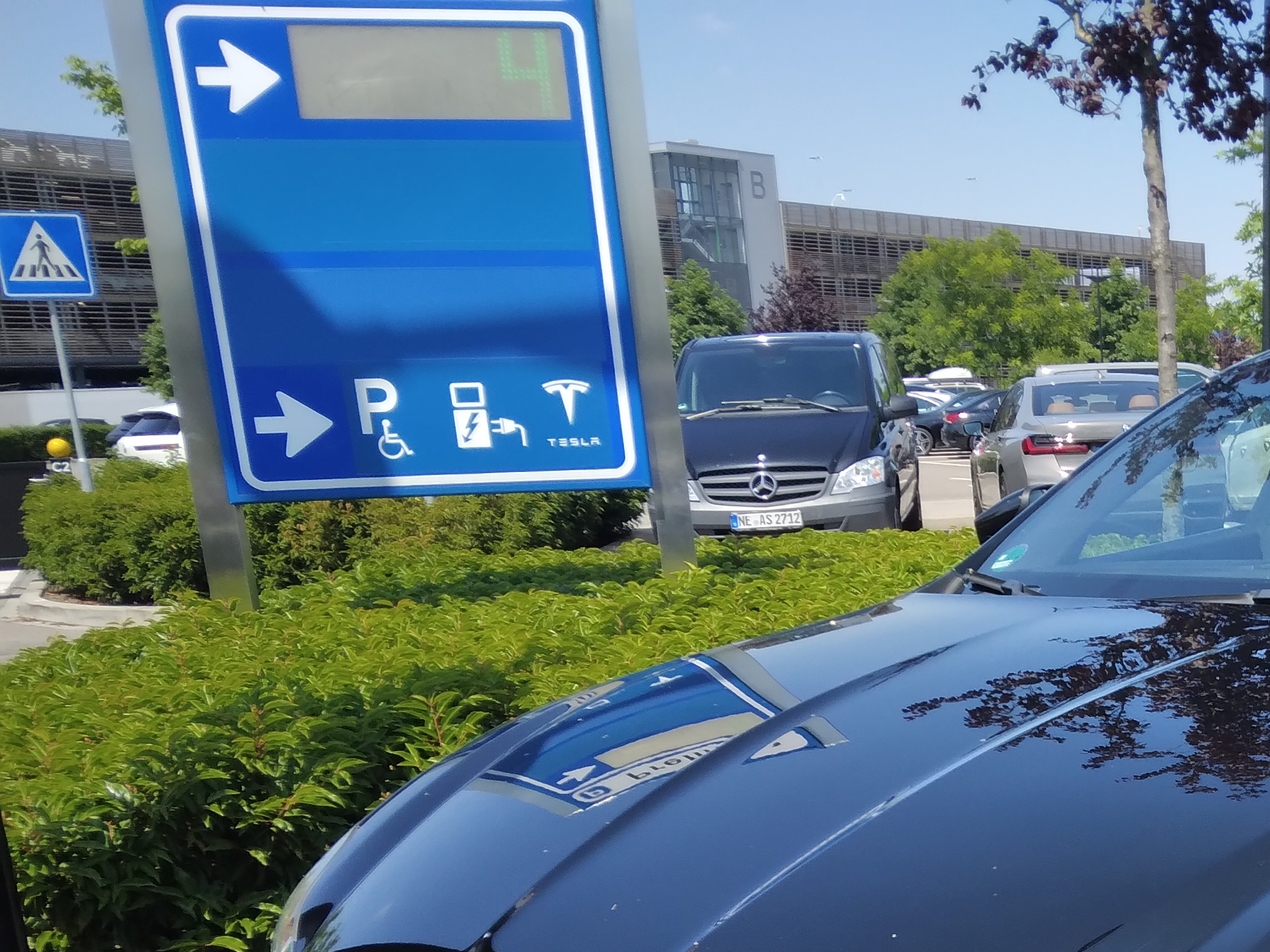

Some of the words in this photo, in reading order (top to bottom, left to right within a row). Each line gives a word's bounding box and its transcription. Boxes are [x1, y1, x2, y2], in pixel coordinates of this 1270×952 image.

[497, 31, 553, 116] 4
[750, 170, 766, 200] B
[353, 378, 398, 435] P
[546, 436, 602, 447] TESLA
[51, 461, 71, 473] C2
[738, 515, 751, 527] NE
[759, 514, 773, 526] AS
[774, 512, 800, 525] 2712
